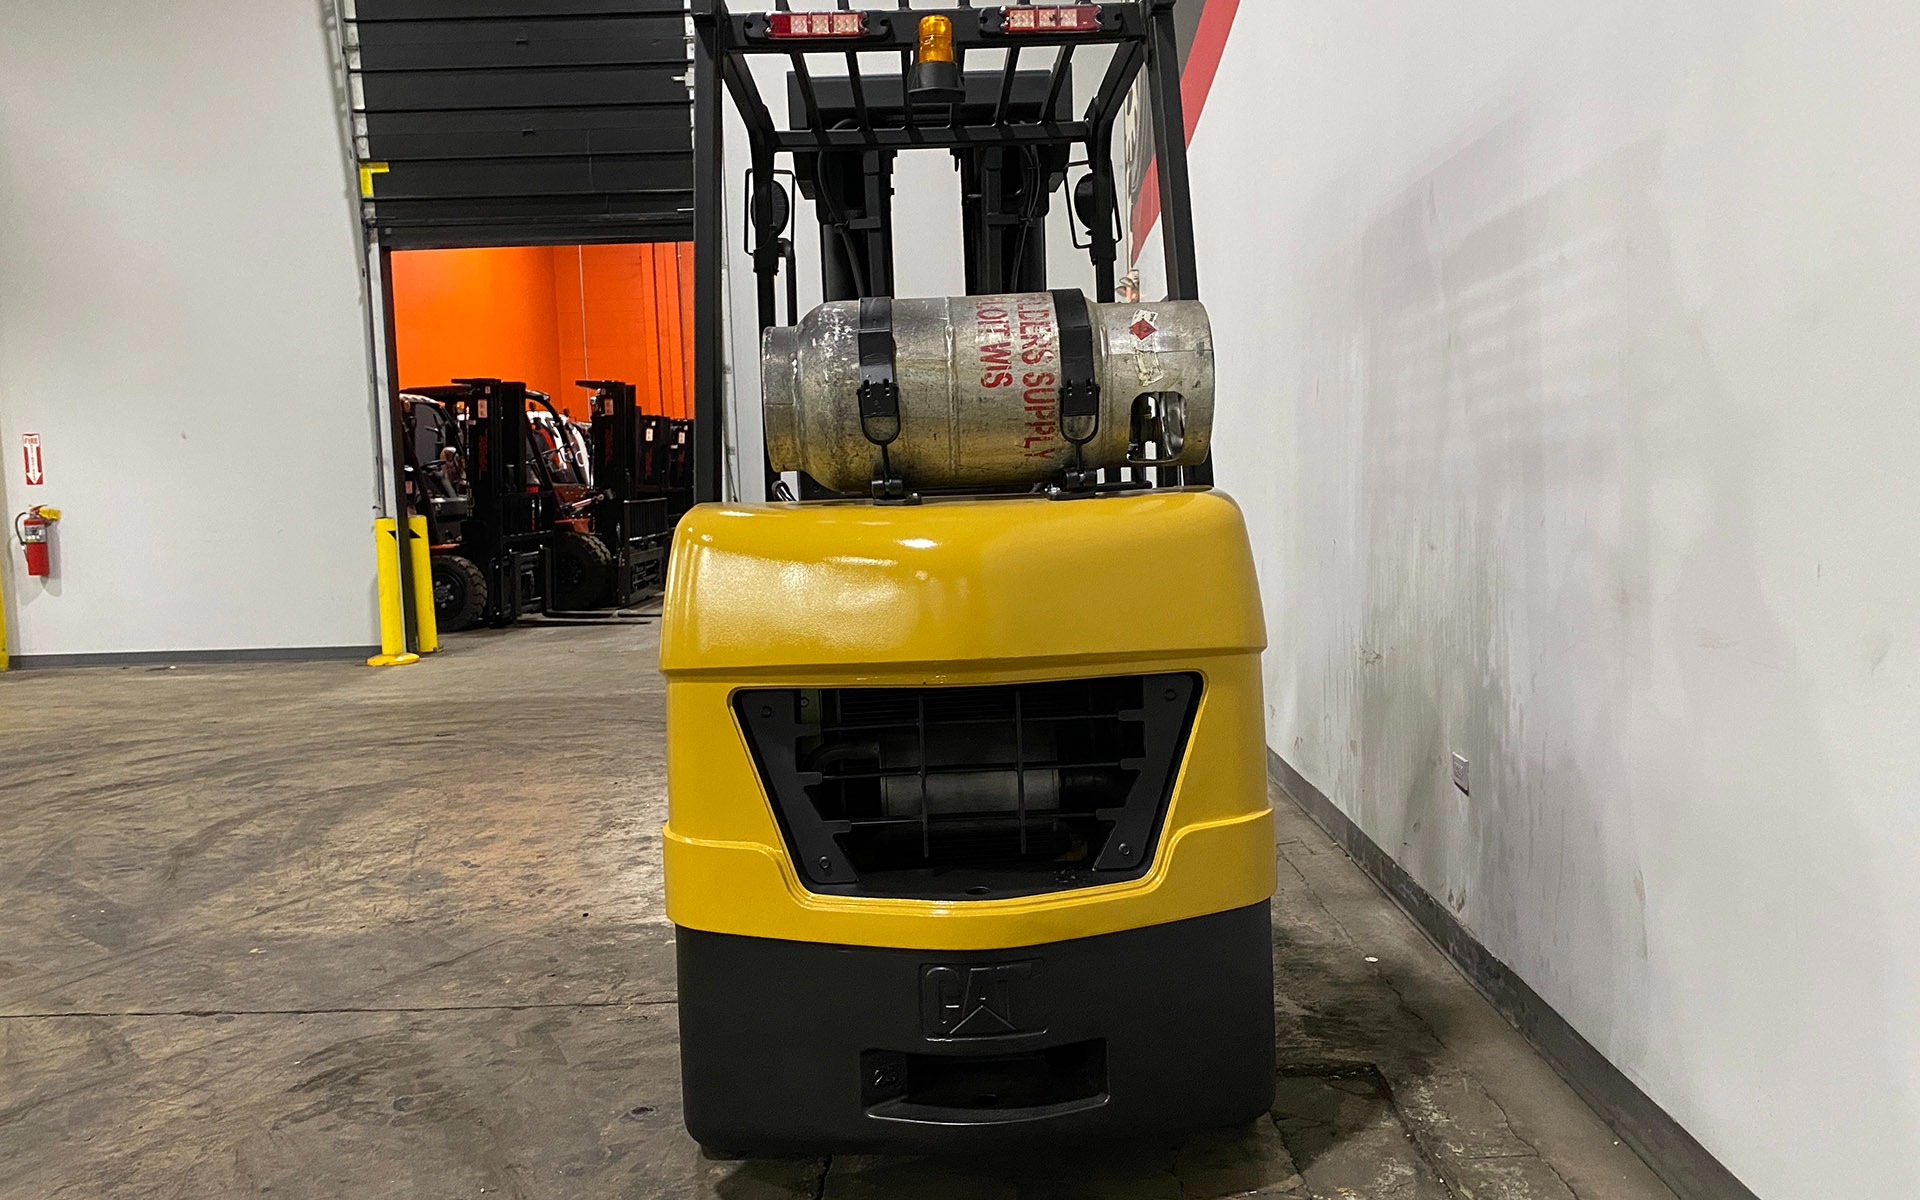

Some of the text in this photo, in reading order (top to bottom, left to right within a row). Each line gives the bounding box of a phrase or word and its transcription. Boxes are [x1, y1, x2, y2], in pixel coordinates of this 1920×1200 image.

[980, 341, 1013, 388] WIS
[1022, 372, 1056, 459] SUPPLY
[924, 962, 1043, 1036] CAT
